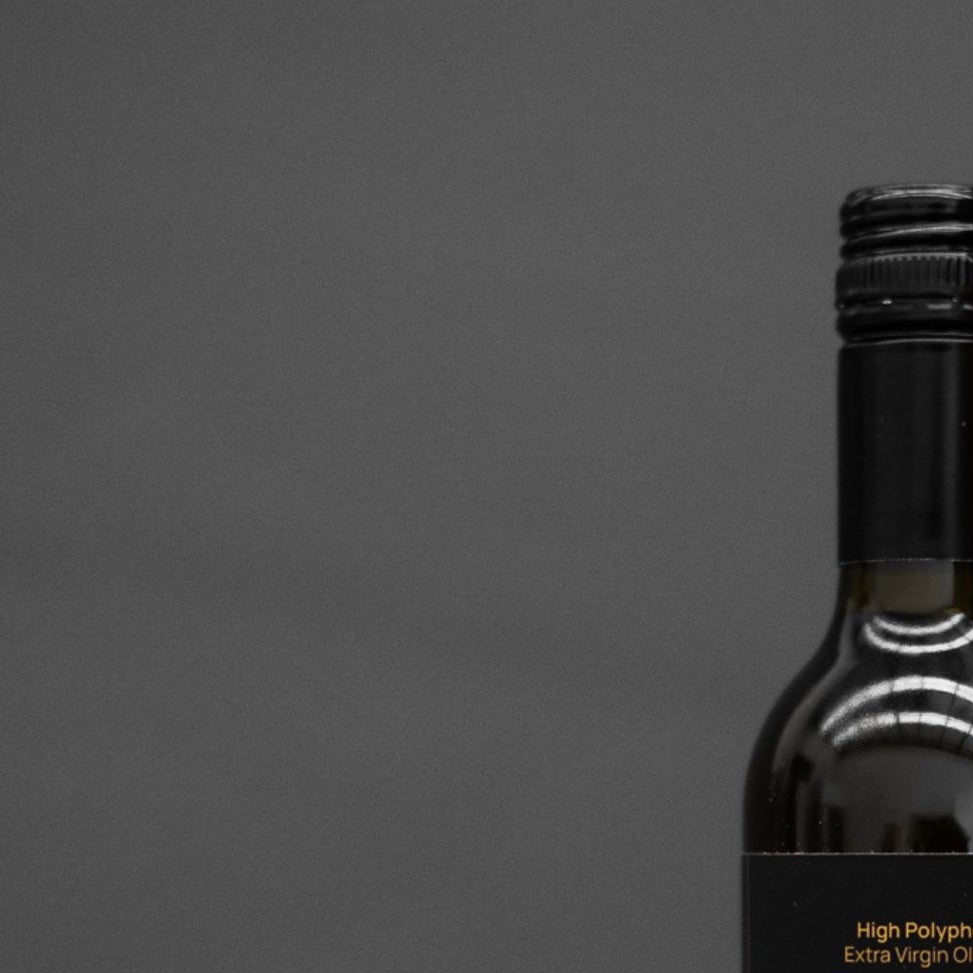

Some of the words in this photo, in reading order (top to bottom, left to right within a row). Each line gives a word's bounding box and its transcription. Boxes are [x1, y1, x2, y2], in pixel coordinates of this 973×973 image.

[857, 921, 900, 943] High
[844, 946, 891, 963] Extra
[895, 946, 949, 968] Virgin
